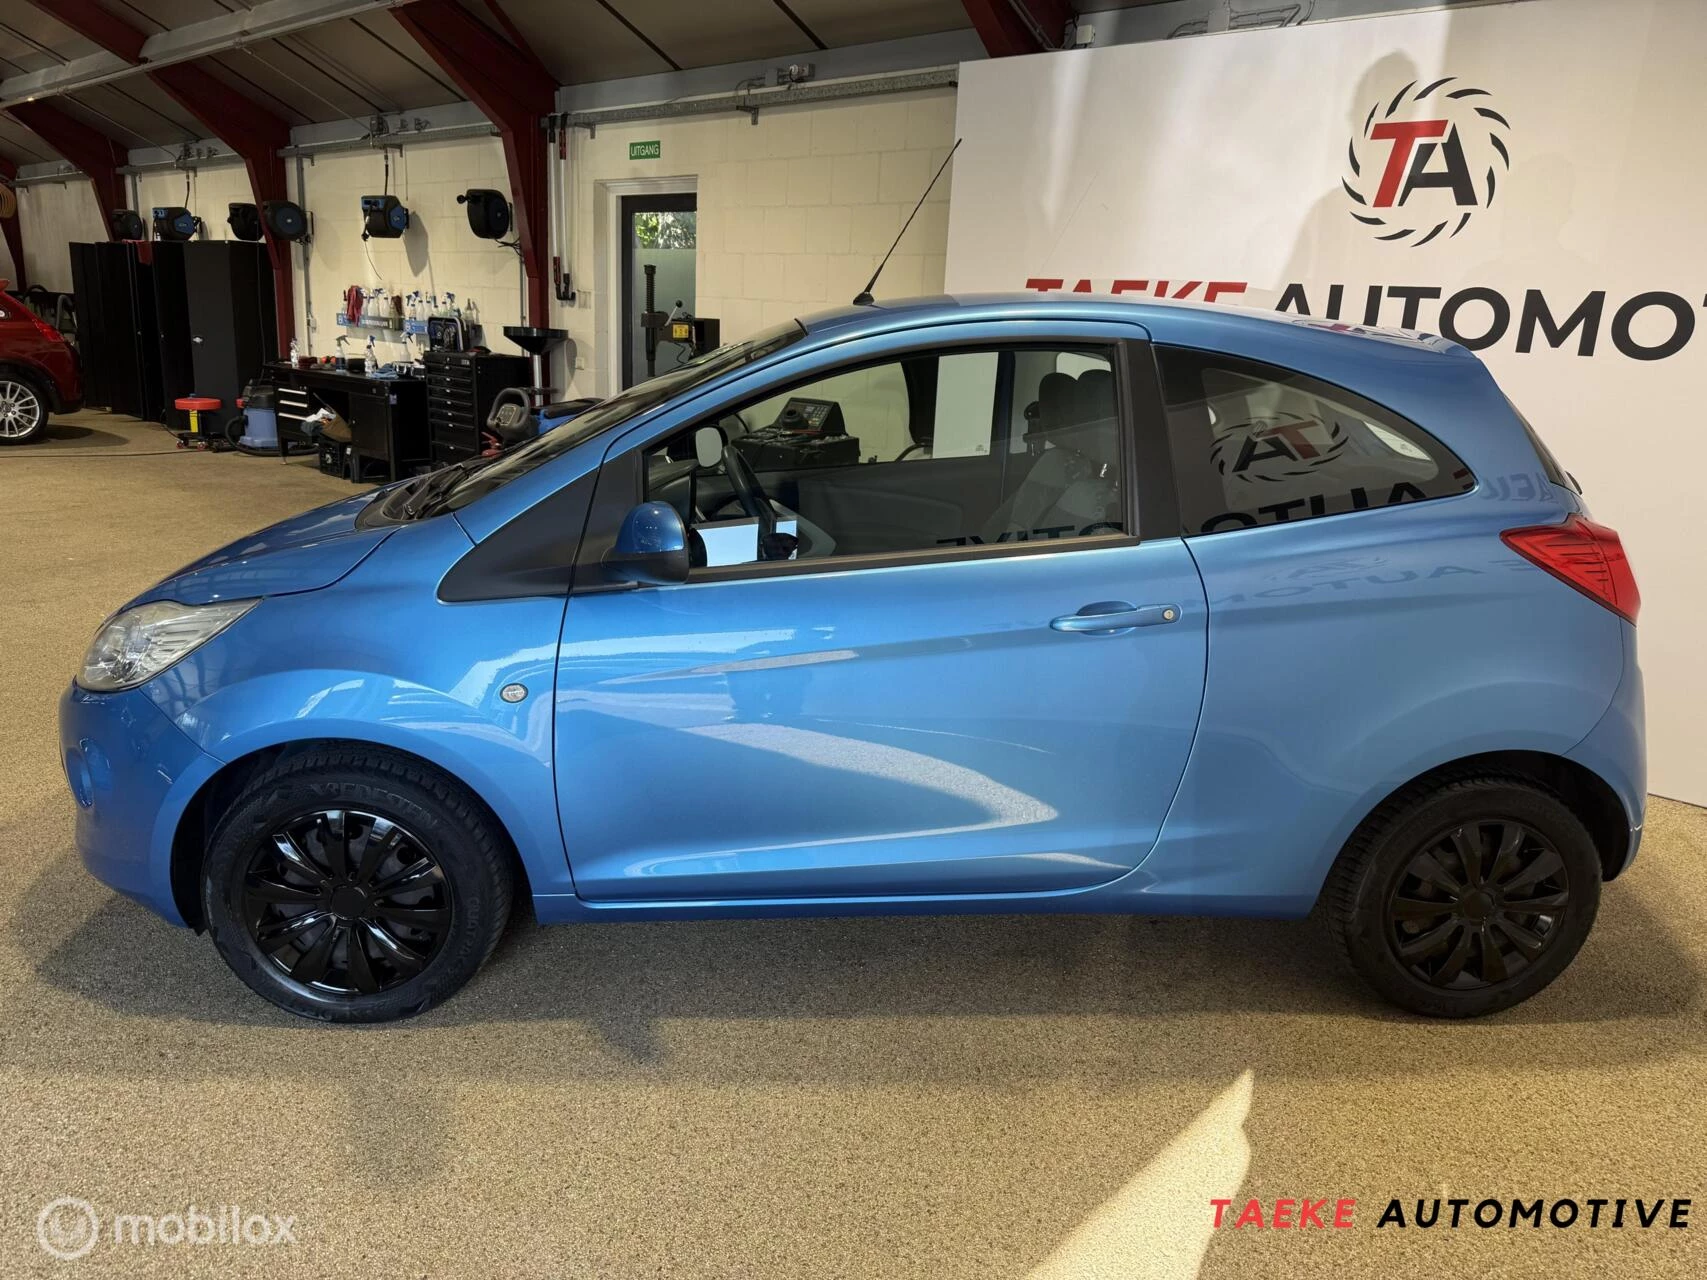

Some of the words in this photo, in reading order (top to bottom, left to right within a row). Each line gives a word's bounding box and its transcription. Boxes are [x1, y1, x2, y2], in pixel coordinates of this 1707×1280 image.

[631, 144, 659, 156] UITGANG
[1370, 119, 1478, 208] TA
[1275, 283, 1707, 361] UTOMO
